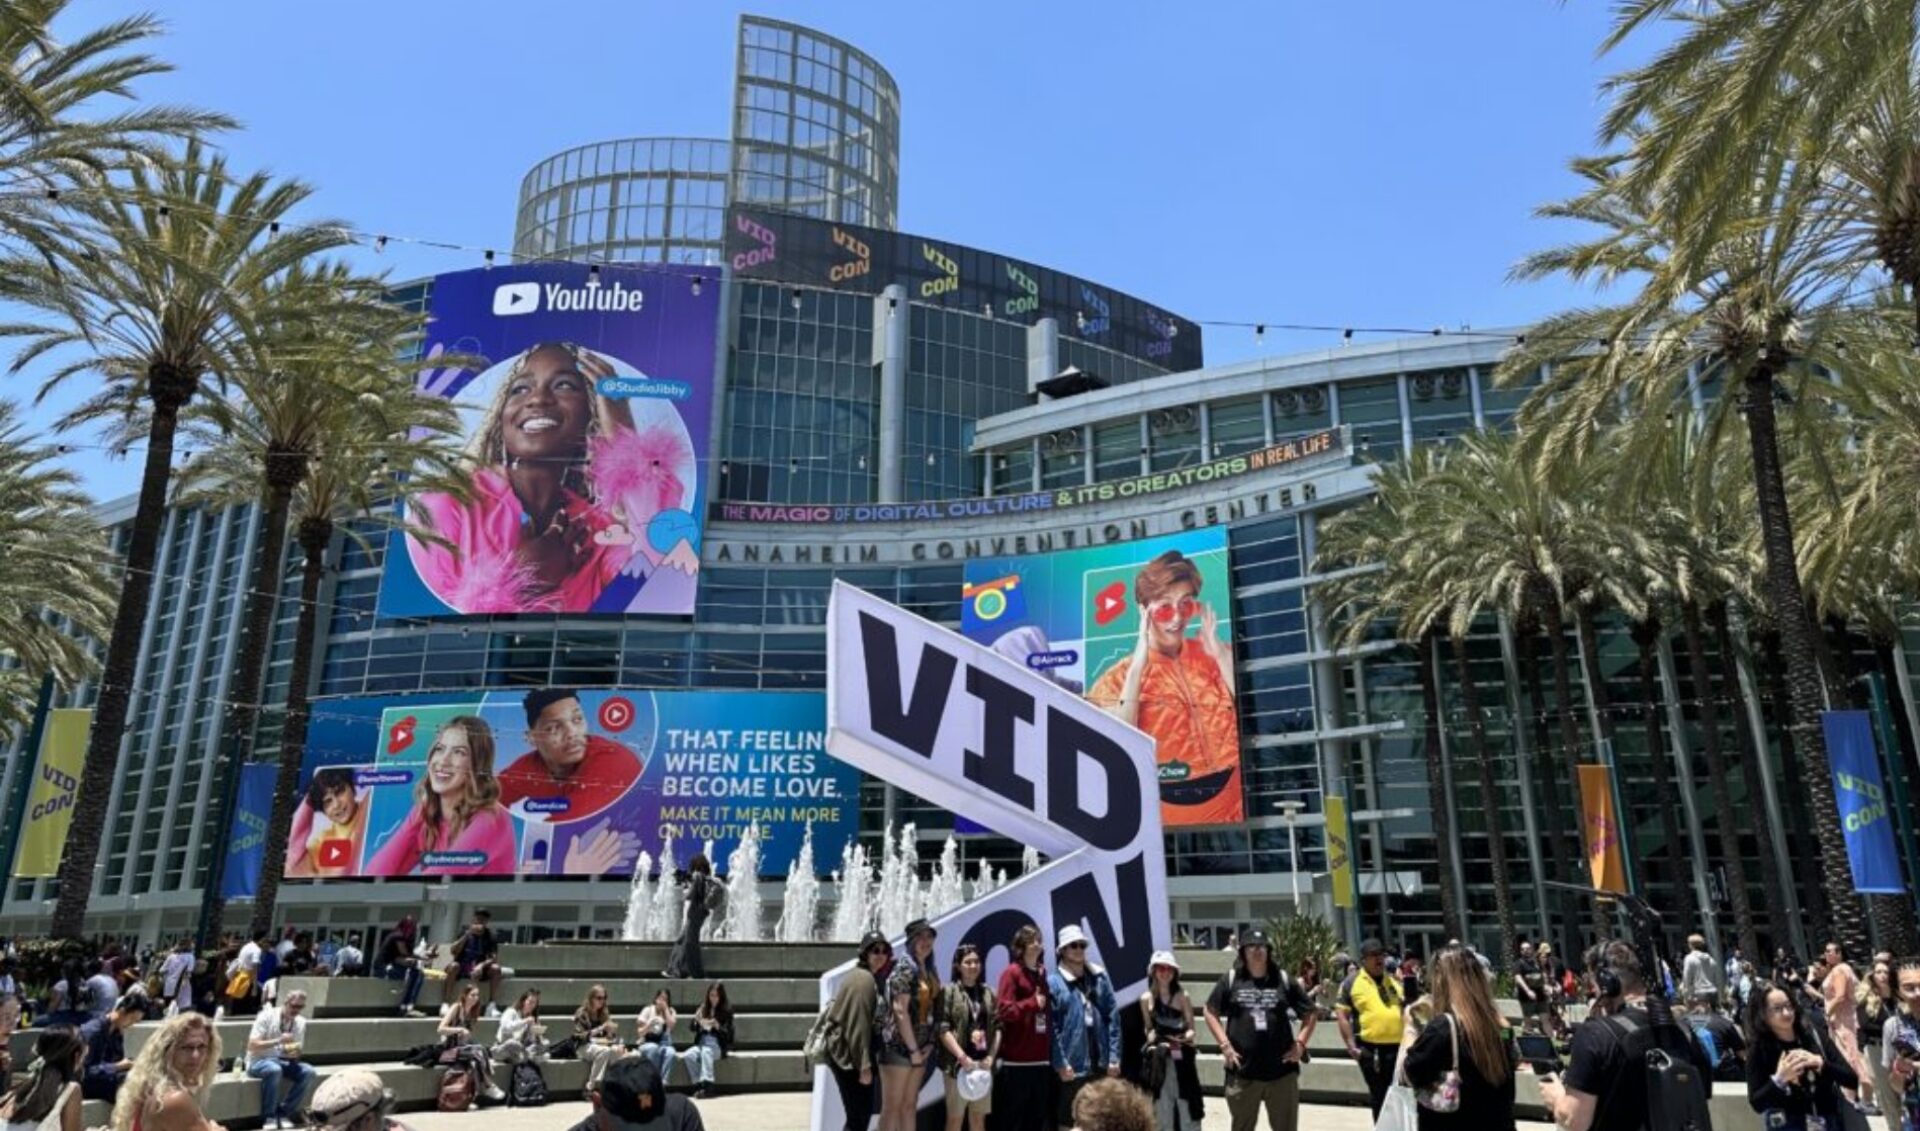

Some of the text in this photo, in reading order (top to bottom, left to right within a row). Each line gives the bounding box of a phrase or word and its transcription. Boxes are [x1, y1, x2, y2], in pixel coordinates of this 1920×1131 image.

[737, 214, 776, 245] VID
[832, 226, 870, 259] VID
[733, 245, 776, 270] CON
[830, 258, 870, 282] CON
[923, 243, 958, 276] VID
[921, 276, 958, 297] CON
[1006, 261, 1038, 295] VID
[545, 282, 643, 312] YouTube
[1005, 295, 1039, 315] CON
[1080, 284, 1110, 318] VID
[1081, 317, 1110, 336] CON
[602, 380, 687, 398] @StudioJibby
[722, 506, 746, 520] THE
[750, 507, 831, 522] MAGIC
[834, 508, 852, 520] OF
[855, 503, 944, 521] DIGITAL
[949, 493, 1052, 518] CULTURE
[1057, 490, 1074, 506] &
[1078, 483, 1115, 503] ITS
[1251, 454, 1265, 470] IN
[1267, 444, 1300, 467] REAL
[1302, 433, 1330, 456] LIFE
[717, 482, 1317, 563] ANAHEIM CONVENTION CENTER
[667, 729, 829, 751] THAT FEELIN
[858, 609, 1143, 852] VID
[43, 763, 77, 792] VID
[665, 753, 816, 774] WHEN LIKES
[662, 776, 843, 798] BECOME LOVE.
[1836, 771, 1883, 800] VID
[32, 792, 75, 821] CON
[659, 805, 841, 823] MAKE IT MEAN MORE
[1845, 802, 1887, 832] CON
[658, 824, 774, 840] ON YOUTUE.
